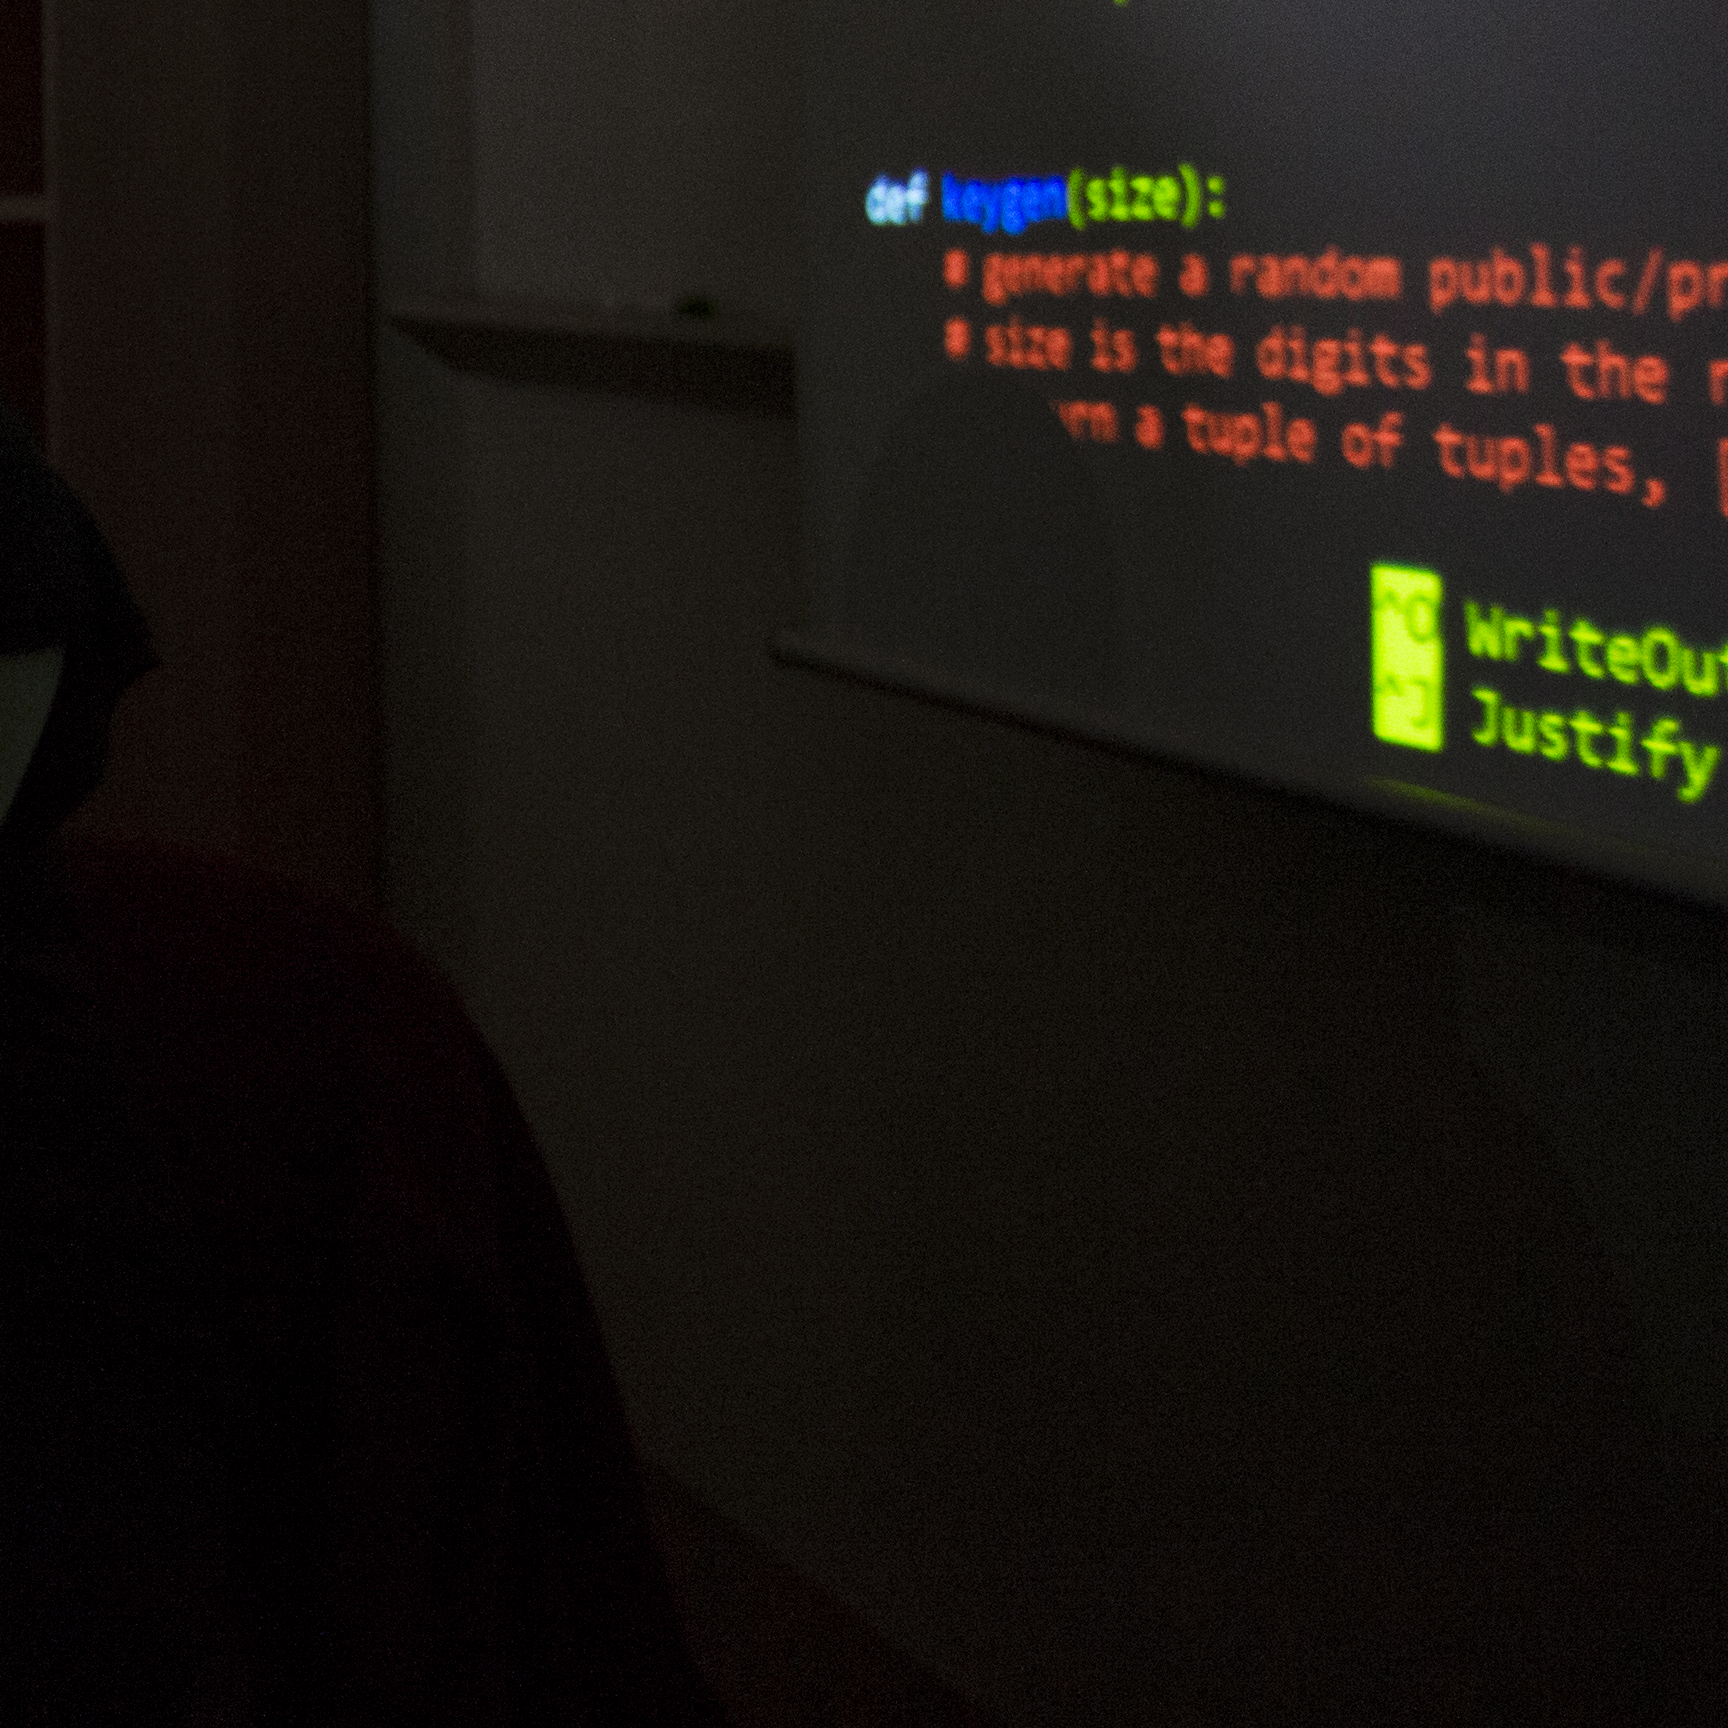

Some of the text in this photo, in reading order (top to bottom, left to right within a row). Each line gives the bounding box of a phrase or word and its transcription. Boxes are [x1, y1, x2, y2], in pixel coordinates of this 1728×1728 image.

[864, 161, 1227, 238] def keygen(size):
[980, 247, 1161, 307] generate
[1177, 252, 1210, 298] a
[1228, 246, 1404, 303] random
[983, 318, 1074, 372] size
[1089, 318, 1139, 374] is
[1154, 322, 1237, 379] the
[1255, 325, 1434, 398] digits
[1464, 332, 1531, 396] in
[1558, 338, 1671, 406] the
[1133, 403, 1166, 450] a
[1180, 399, 1319, 466] tuple
[1340, 409, 1405, 470] of
[1431, 421, 1668, 509] tuples,
[1462, 598, 1728, 701] WriteOu
[1469, 683, 1723, 806] Justify
